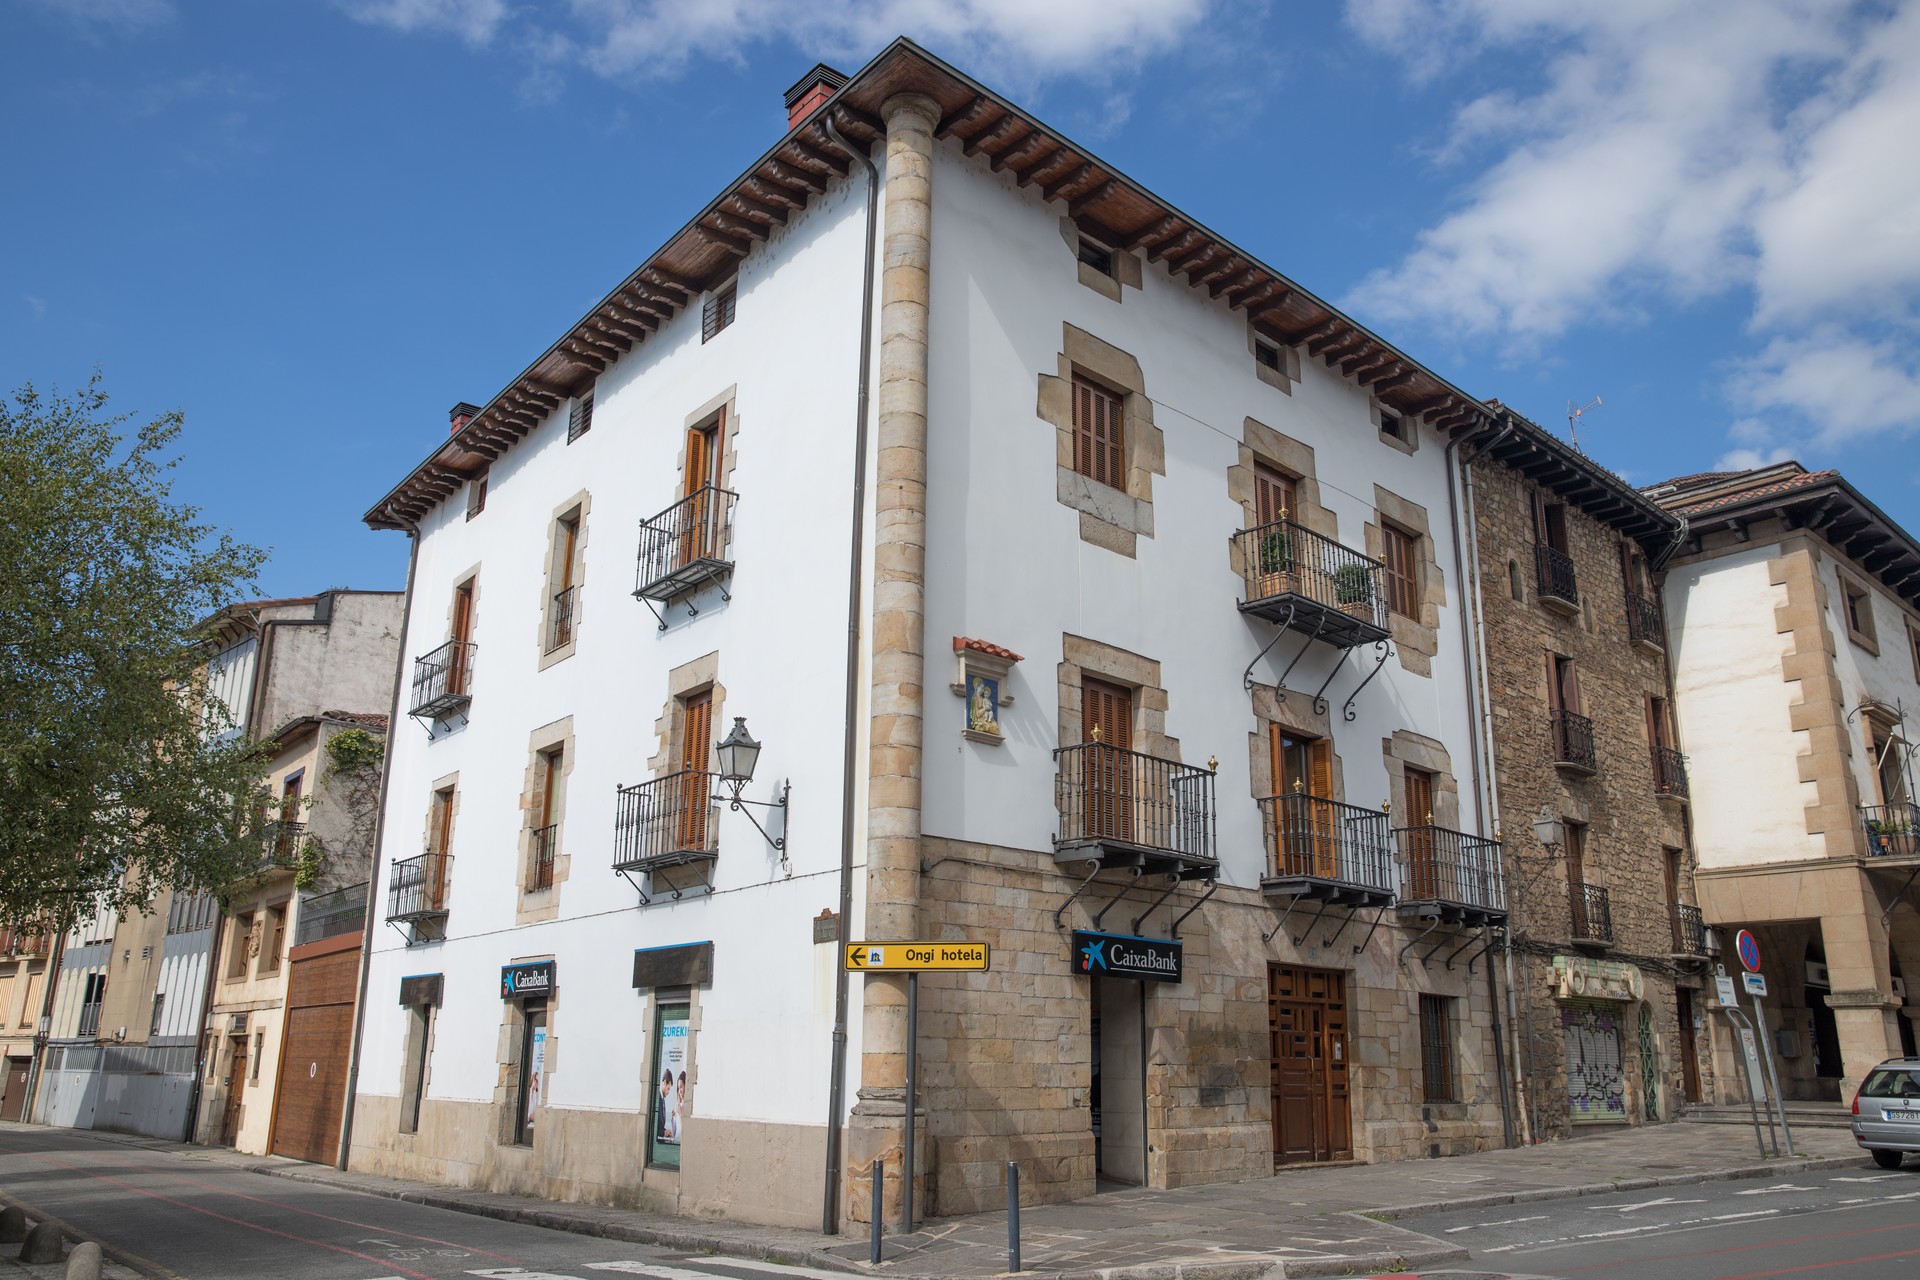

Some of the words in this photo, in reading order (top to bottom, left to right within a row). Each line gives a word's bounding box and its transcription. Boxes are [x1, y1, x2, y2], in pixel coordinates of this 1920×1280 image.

[905, 949, 935, 963] Ongi
[941, 949, 983, 961] hotela
[1110, 944, 1177, 971] CaixaBank
[515, 969, 549, 988] CaixaBank
[662, 1026, 689, 1037] ZUREKI
